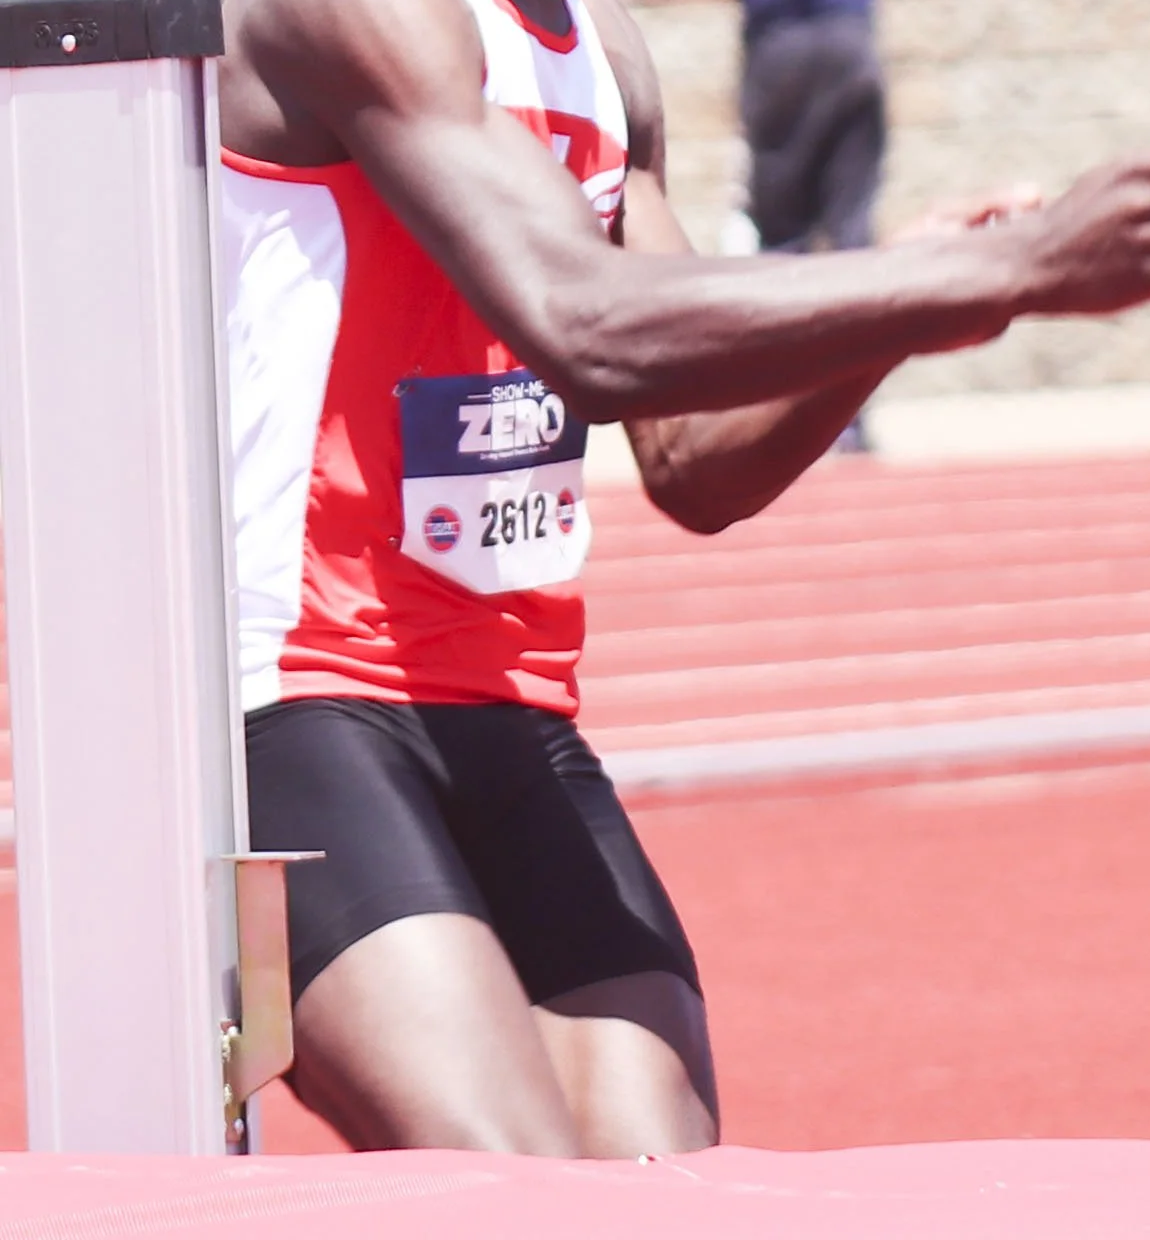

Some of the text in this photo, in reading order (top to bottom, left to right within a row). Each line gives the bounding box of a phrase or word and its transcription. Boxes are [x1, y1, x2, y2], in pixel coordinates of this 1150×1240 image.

[491, 379, 546, 402] SHOW-ME
[458, 393, 565, 454] ZERO
[479, 492, 548, 548] 2612
